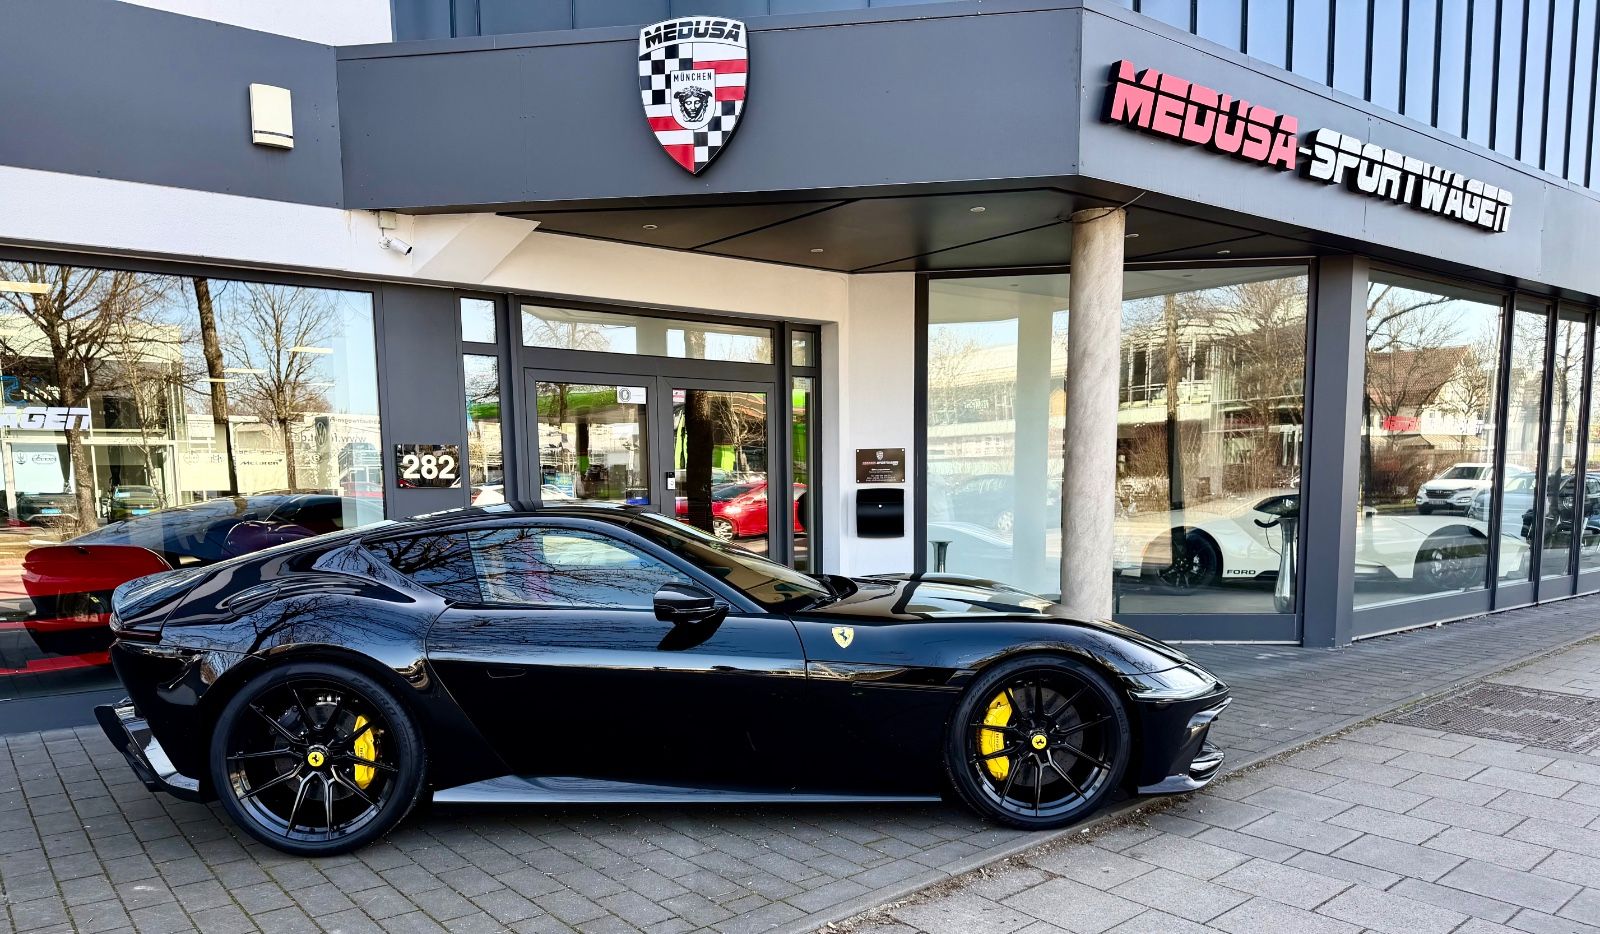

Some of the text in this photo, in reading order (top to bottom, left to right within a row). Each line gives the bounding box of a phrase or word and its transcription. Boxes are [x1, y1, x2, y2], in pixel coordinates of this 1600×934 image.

[645, 20, 741, 49] MEDUSA
[673, 72, 712, 83] MÜNCHEN
[1110, 59, 1513, 233] MEDUSA-SPORTWAGEN
[402, 454, 456, 480] 282
